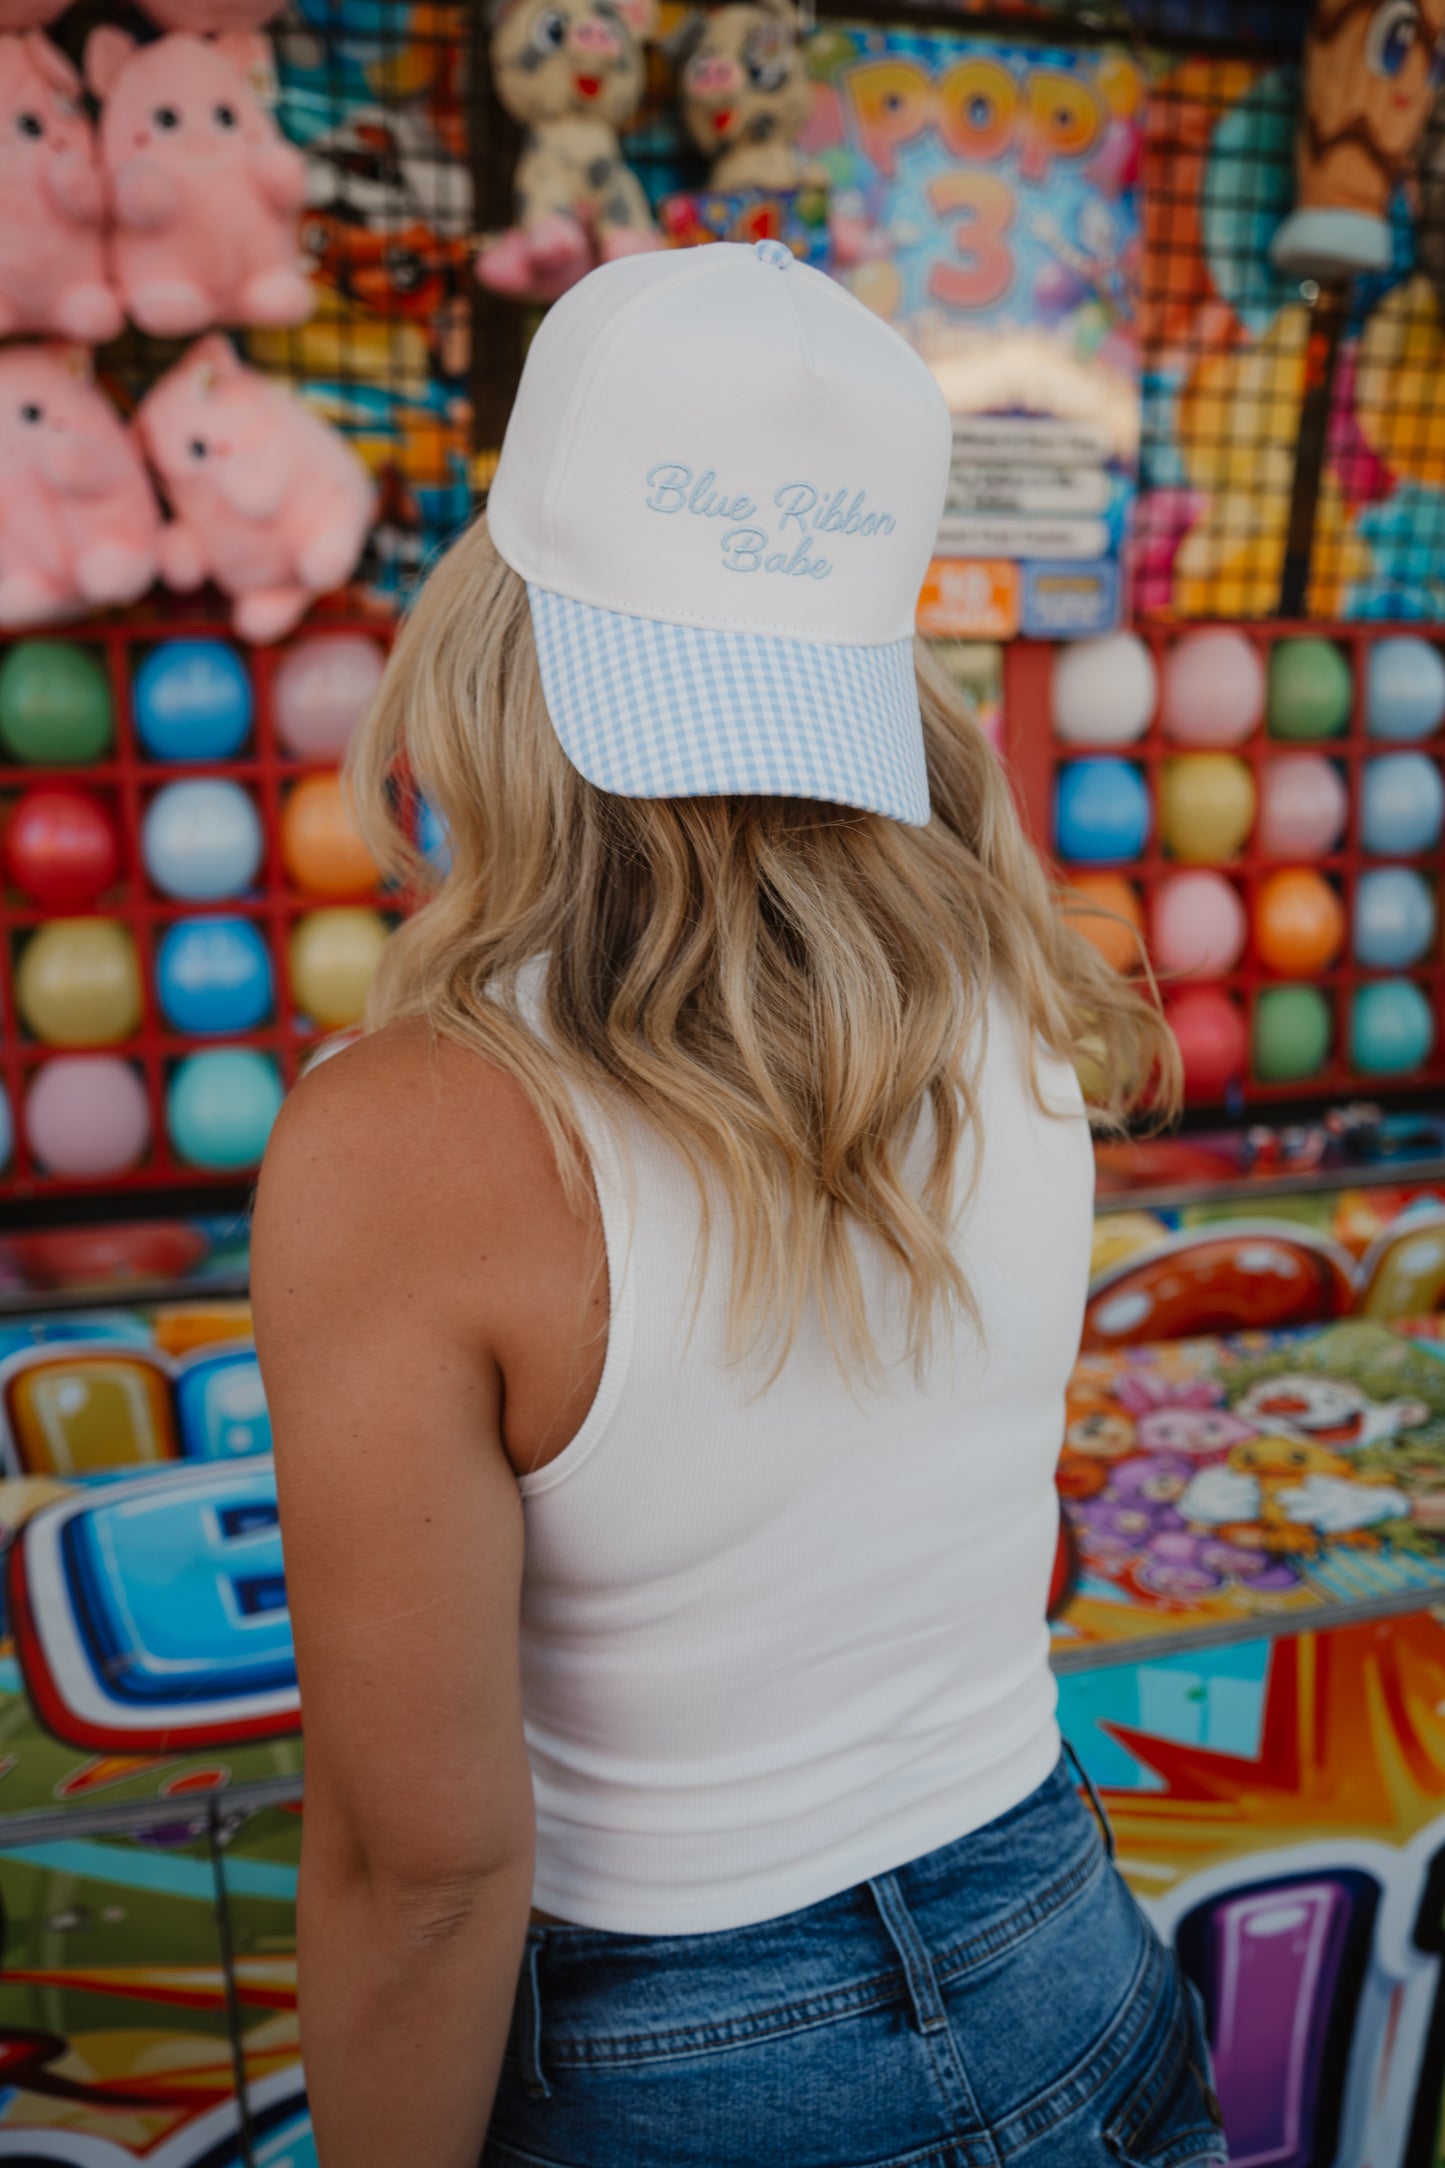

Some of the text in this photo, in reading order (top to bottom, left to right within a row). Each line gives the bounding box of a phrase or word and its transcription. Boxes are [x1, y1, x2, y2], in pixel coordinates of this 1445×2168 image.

[846, 58, 1100, 184] POP
[926, 171, 1016, 309] 3
[646, 461, 897, 537] Blue Ribbon
[720, 526, 833, 580] Babe
